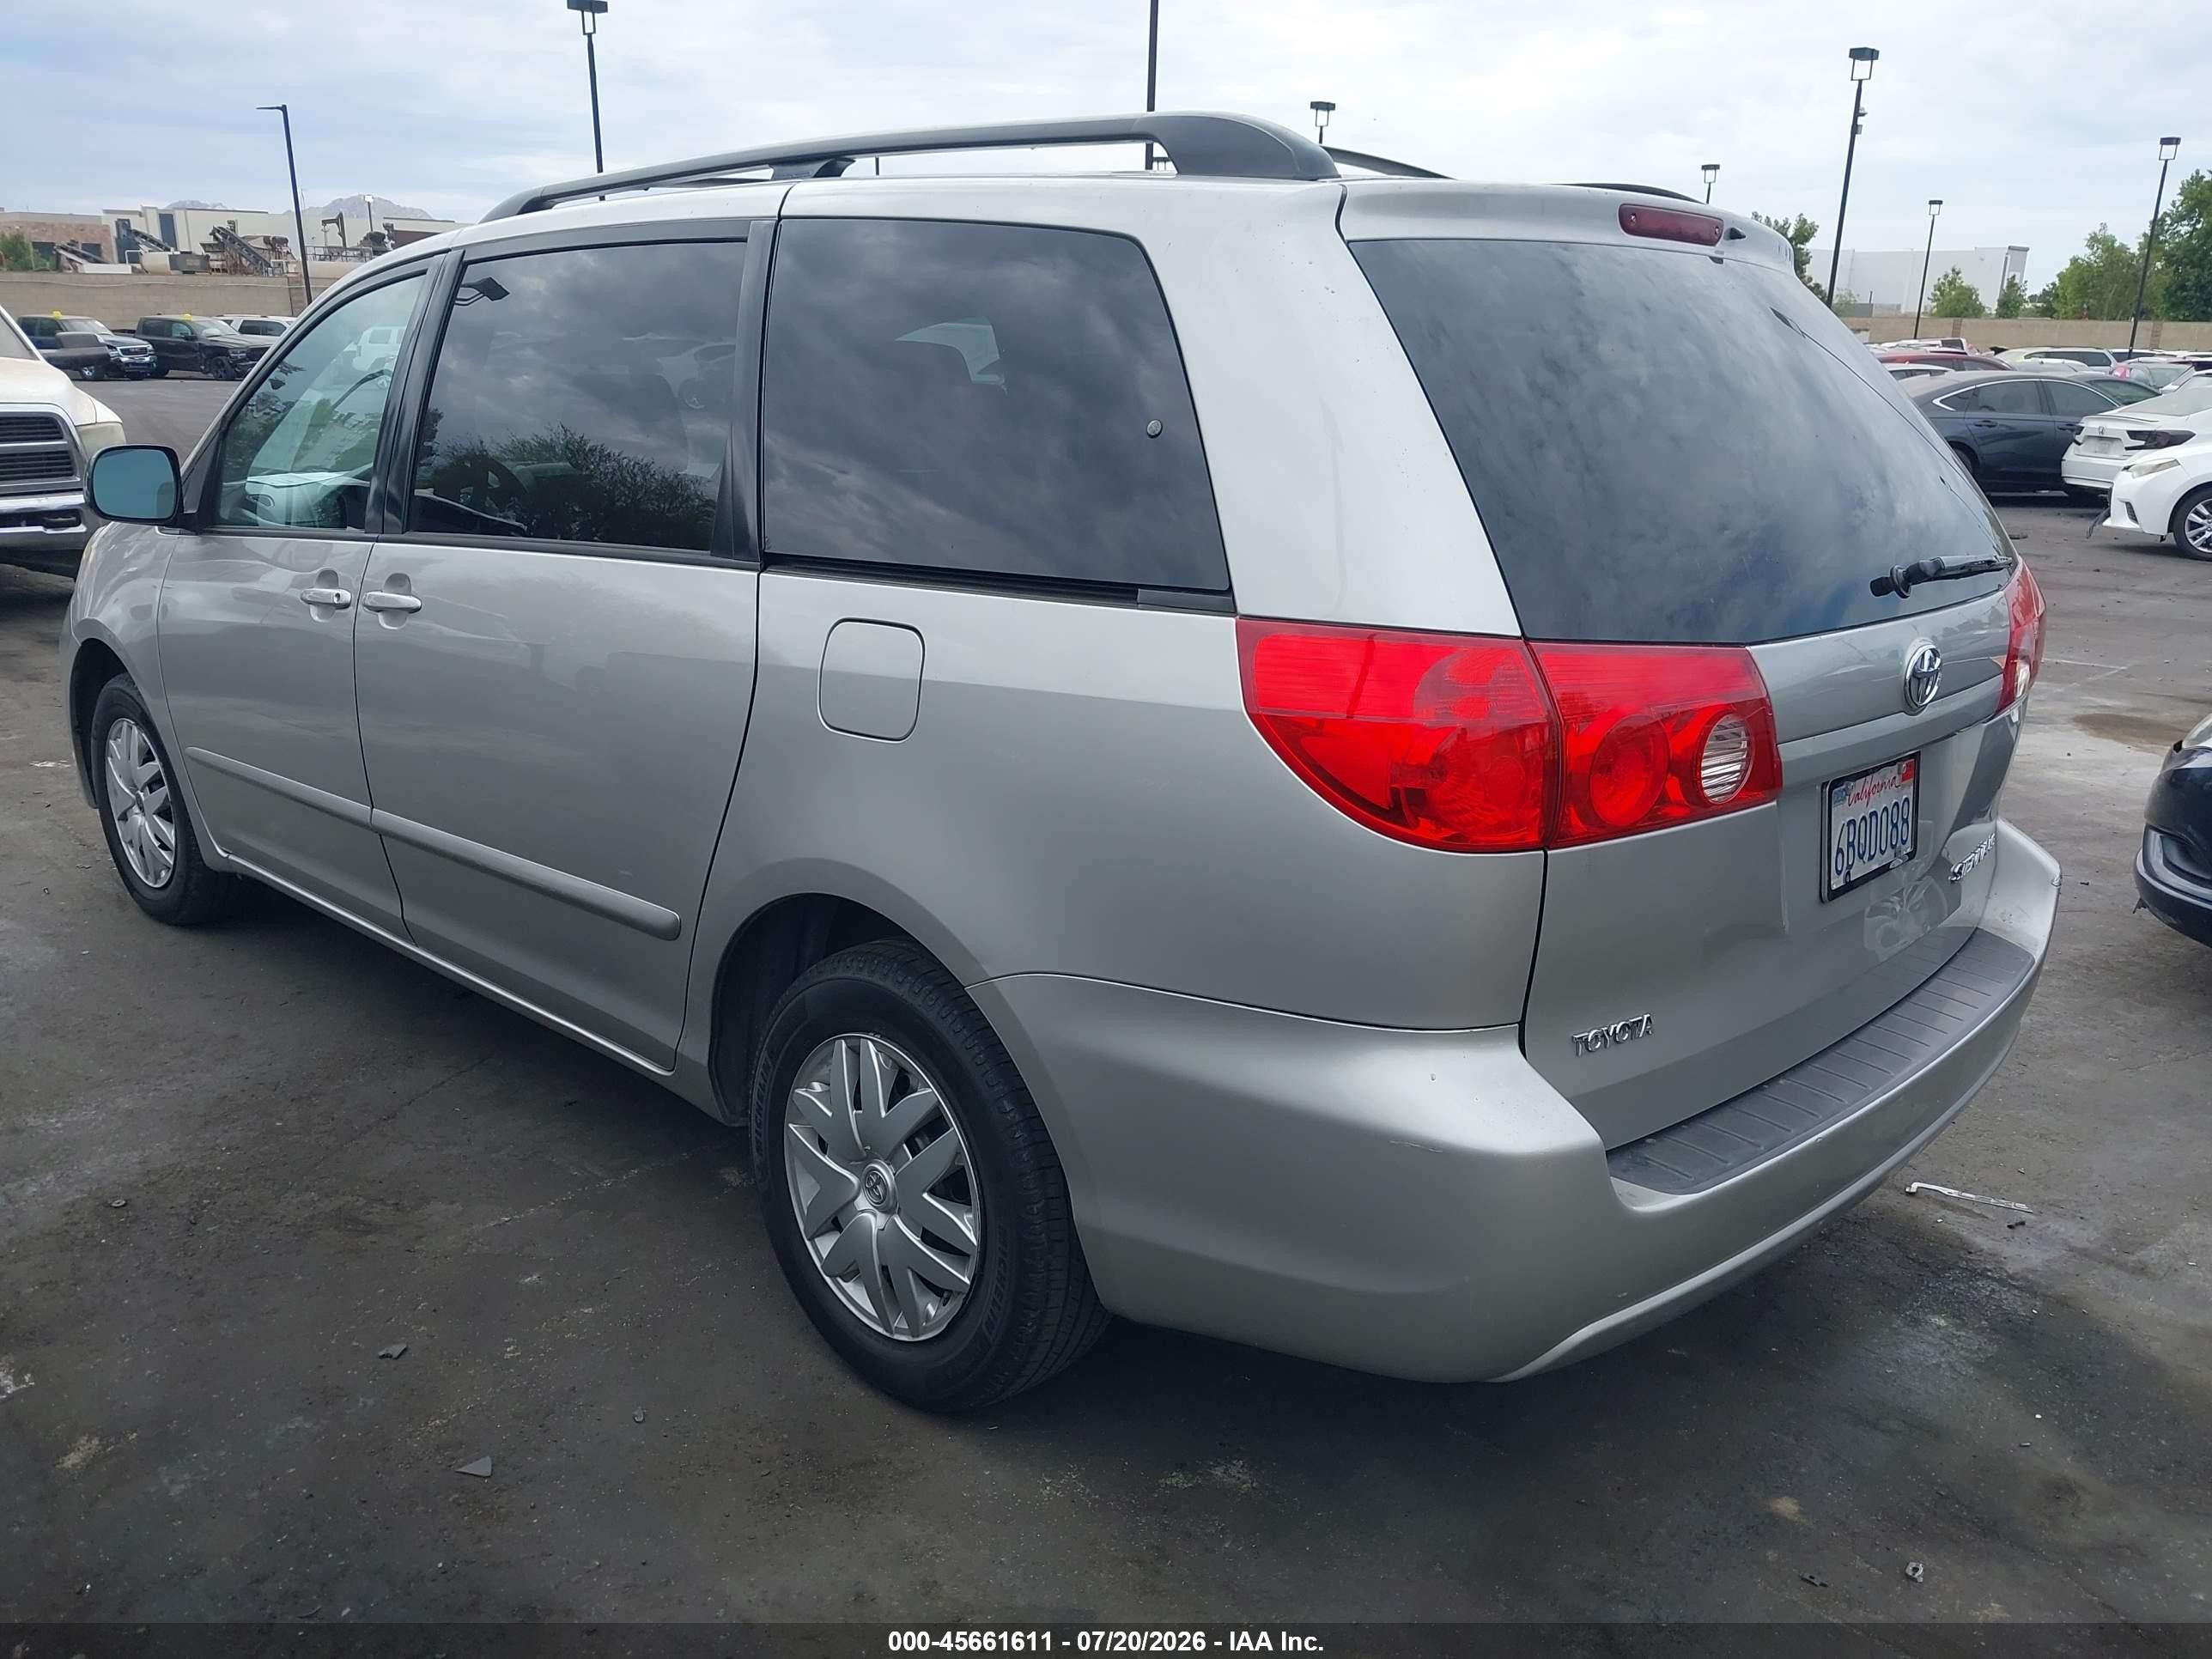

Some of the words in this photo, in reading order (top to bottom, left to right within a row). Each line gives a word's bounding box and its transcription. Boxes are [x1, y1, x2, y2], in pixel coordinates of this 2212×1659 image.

[1847, 775, 1900, 808] California
[1834, 795, 1911, 877] 6BQD088
[1571, 1013, 1654, 1057] TOYOTA
